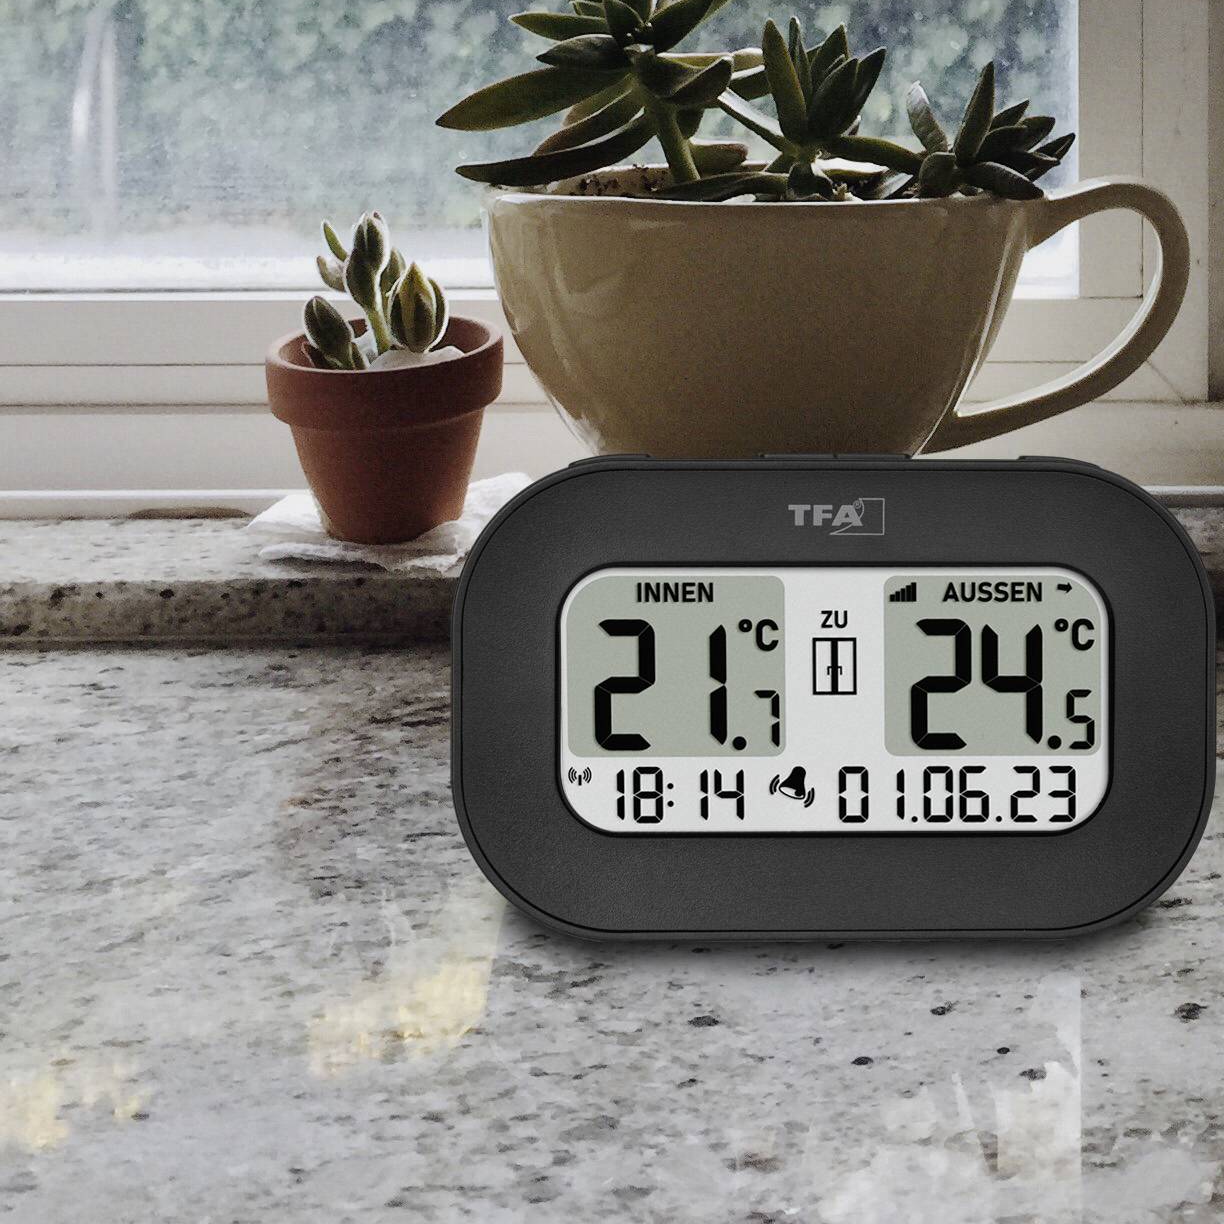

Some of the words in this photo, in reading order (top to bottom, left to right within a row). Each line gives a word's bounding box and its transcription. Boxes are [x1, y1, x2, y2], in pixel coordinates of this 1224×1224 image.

[787, 504, 864, 527] TFA
[636, 582, 715, 603] INNEN
[942, 581, 1043, 603] AUSSEN
[820, 610, 848, 629] ZU
[910, 618, 1095, 750] 24.5
[838, 765, 1076, 823] 01.06.23
